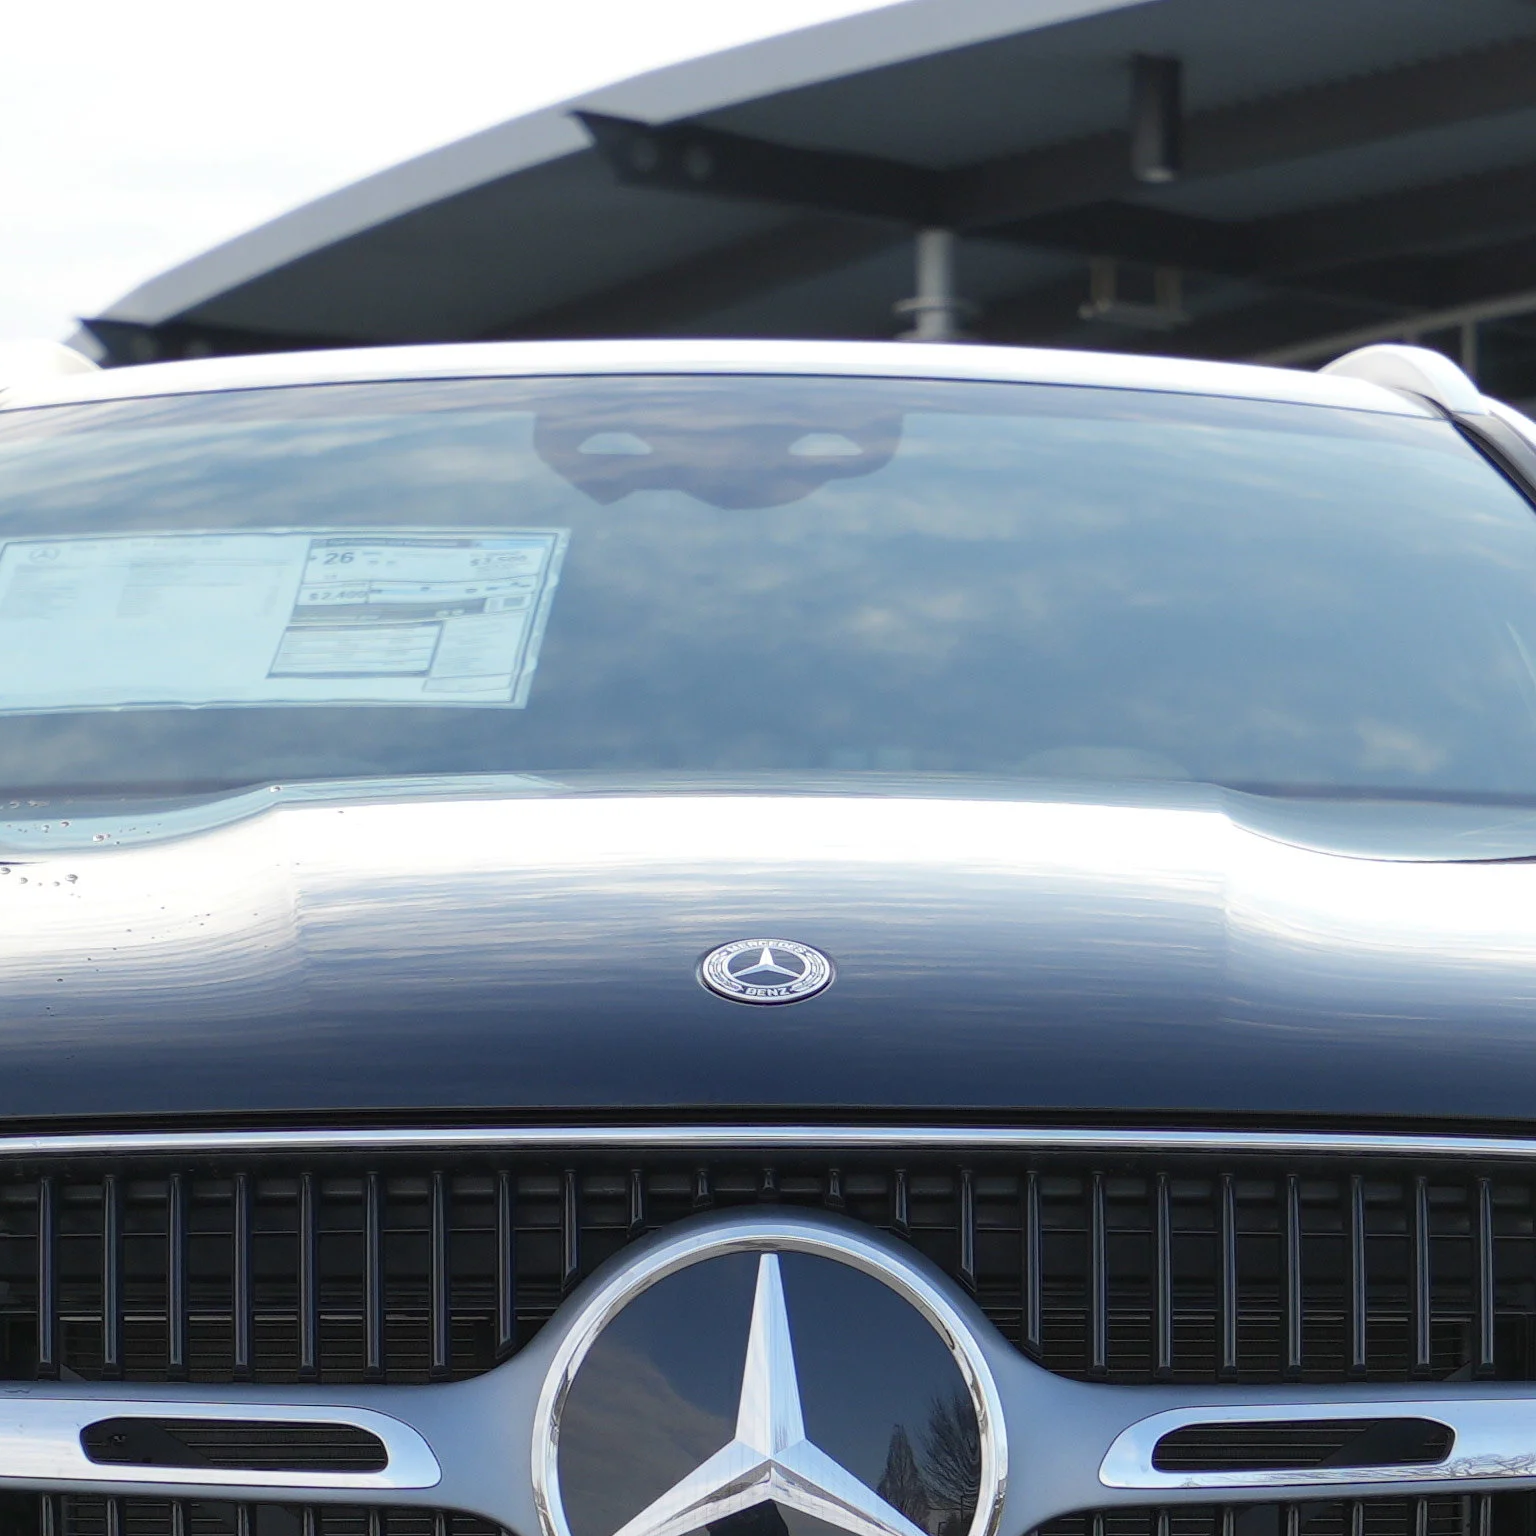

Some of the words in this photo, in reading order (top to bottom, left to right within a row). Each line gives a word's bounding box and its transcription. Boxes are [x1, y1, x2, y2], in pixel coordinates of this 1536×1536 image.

[323, 551, 355, 565] 26
[726, 940, 807, 954] MERCEDES
[745, 986, 791, 997] BENZ
